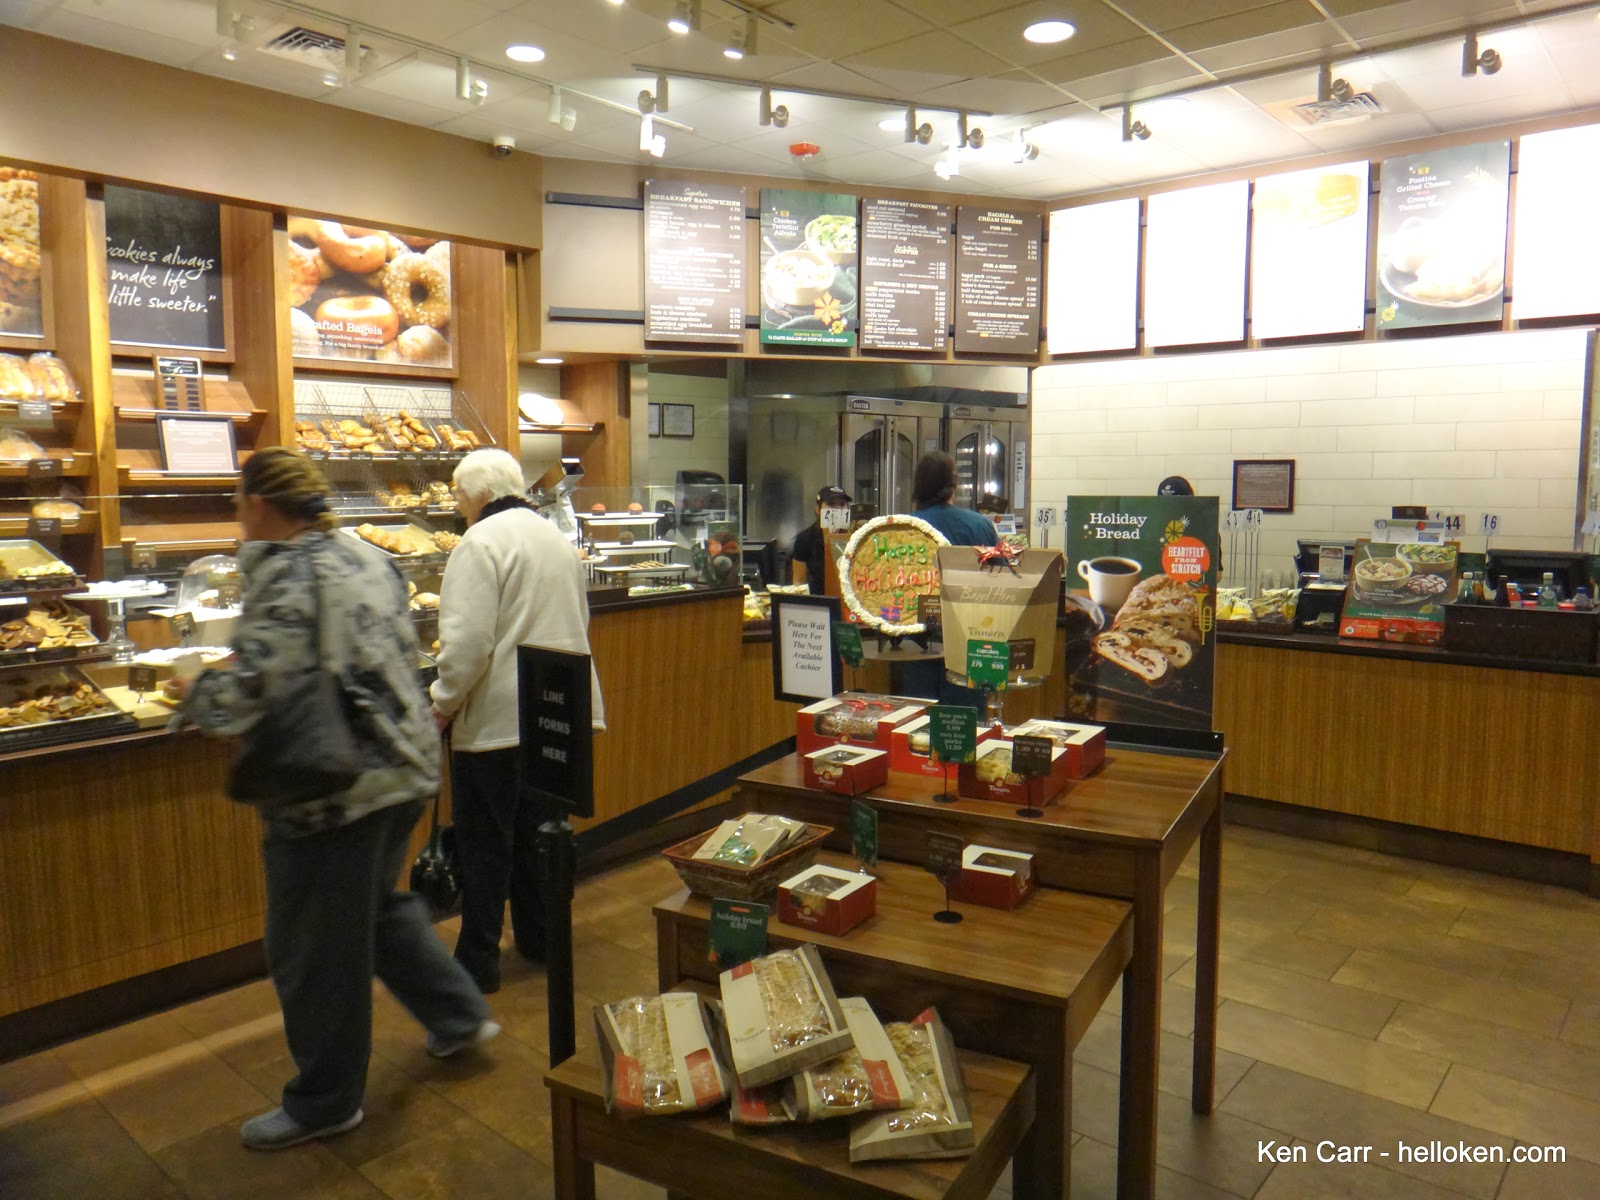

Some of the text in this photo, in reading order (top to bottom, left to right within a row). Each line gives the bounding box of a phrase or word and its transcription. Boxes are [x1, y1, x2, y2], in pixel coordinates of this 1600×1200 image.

[1409, 176, 1437, 184] Fontina
[1396, 180, 1451, 193] Grilled Cheese
[684, 188, 708, 198] Signature
[650, 194, 741, 207] BREAKFAST SANDWICHES
[910, 202, 938, 210] FAVORITES
[772, 218, 798, 226] Chicken
[772, 224, 799, 232] Tortellini
[894, 248, 919, 256] COFFEE
[161, 244, 215, 281] always
[110, 264, 189, 296] make life
[108, 283, 143, 307] little
[346, 321, 383, 336] Bagels
[1038, 510, 1050, 523] 35
[1090, 512, 1148, 528] Holiday
[1484, 513, 1498, 530] 16
[1446, 516, 1461, 530] 44
[1095, 528, 1140, 540] Bread
[870, 535, 927, 565] Happy
[1168, 546, 1206, 558] HEARTFELT
[1171, 564, 1200, 575] SCRATCH
[853, 566, 940, 595] Holidays
[960, 584, 1017, 602] Bagel Hero
[788, 620, 826, 631] Please Wait
[792, 630, 822, 640] Here For
[968, 626, 1006, 638] Panera
[793, 640, 823, 652] The Next
[976, 648, 1000, 656] cupcakes
[792, 652, 824, 662] Available
[796, 662, 821, 672] Cashier
[544, 689, 565, 705] LINE
[538, 716, 570, 736] FORMS
[542, 746, 567, 763] HERE
[922, 764, 938, 772] Panera
[818, 776, 836, 786] Panera
[989, 784, 1010, 793] Panera
[716, 912, 763, 926] holiday bread
